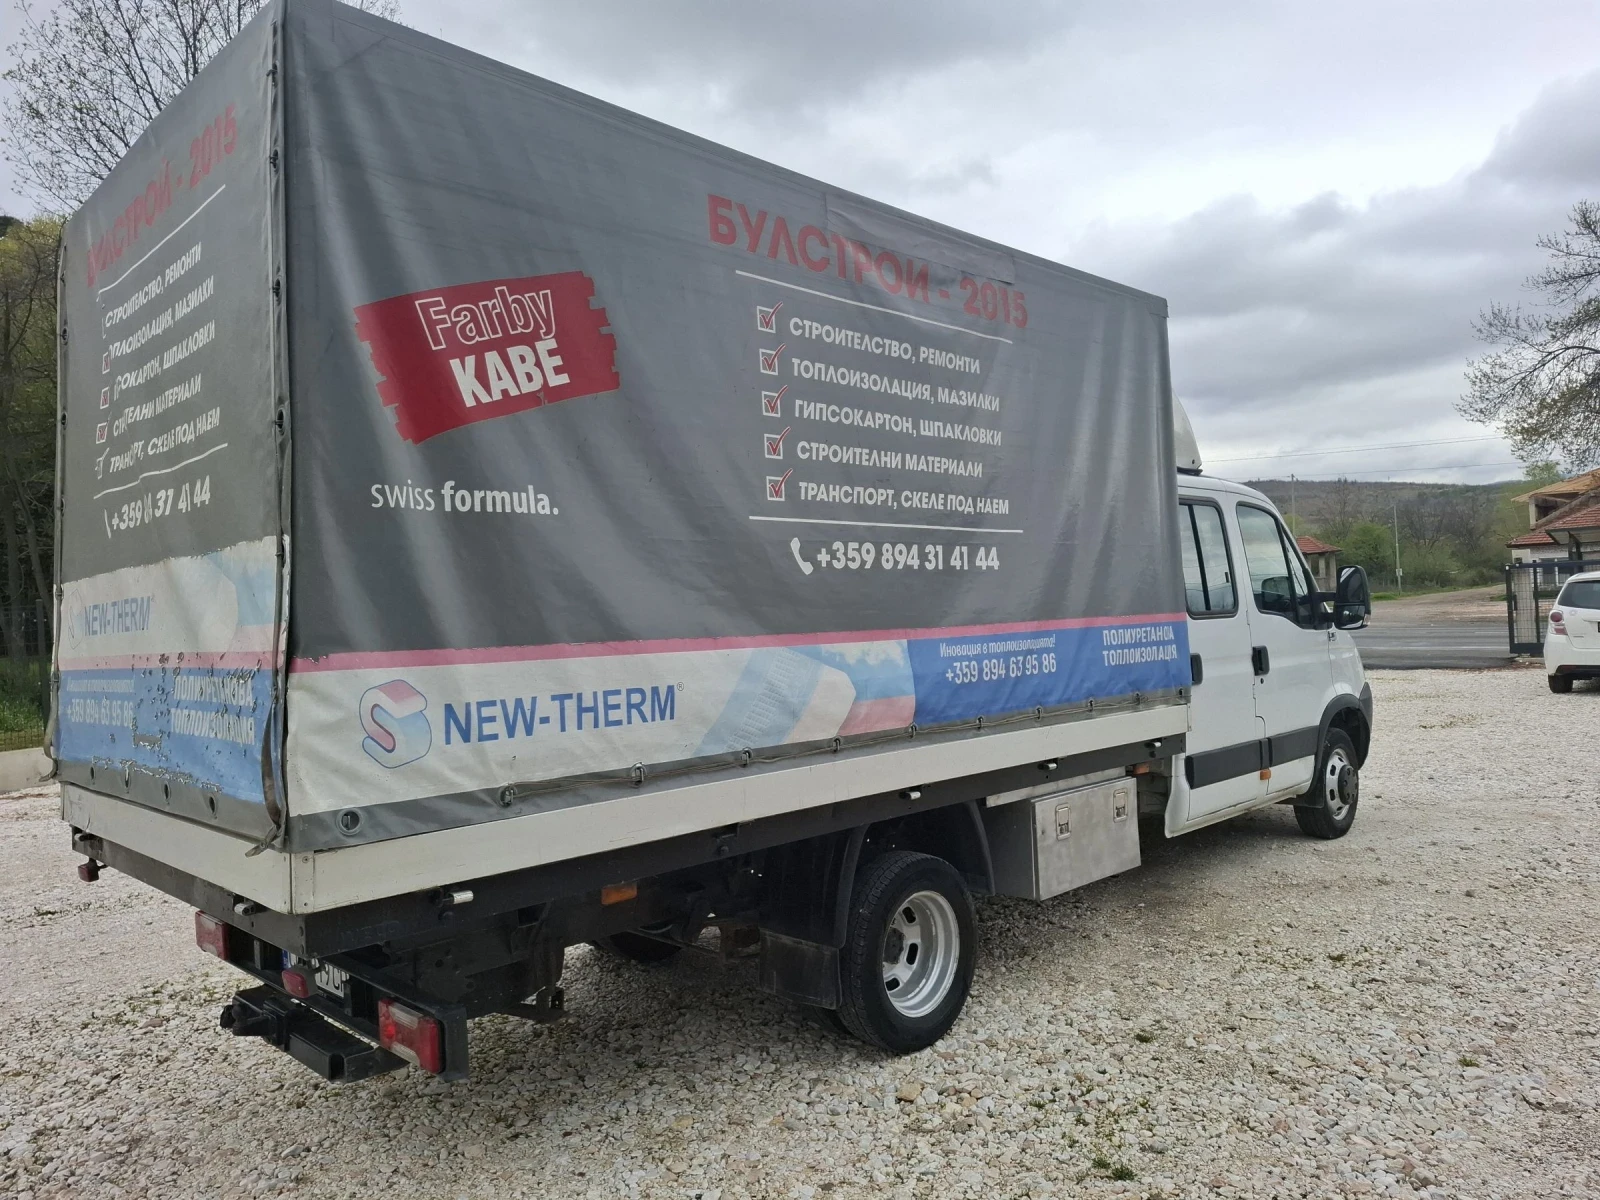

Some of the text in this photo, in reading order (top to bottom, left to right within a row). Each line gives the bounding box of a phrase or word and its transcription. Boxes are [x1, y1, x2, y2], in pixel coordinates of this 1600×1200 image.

[190, 103, 238, 189] 2015
[165, 241, 202, 287] РЕМОНТИ
[175, 275, 214, 322] МАЗИЛКИ
[415, 286, 555, 350] Farby
[960, 277, 1028, 328] 2015
[163, 319, 215, 369] ШПАКЛОВКИ
[789, 318, 980, 374] СТРОИТЕЛСТВО, РЕМОНТИ
[449, 338, 570, 408] KABE
[792, 358, 999, 412] ТОПЛОИЗОЛАЦИЯ, МАЗИЛКИ
[175, 420, 195, 445] ПОД
[196, 406, 220, 436] НАЕМ
[795, 399, 1001, 446] ГИПСОКАРТОН, ШПАКЛОВКИ
[797, 441, 983, 478] СТРОИТЕЛНИ МАТЕРИАЛИ
[112, 500, 142, 530] +359
[193, 475, 211, 507] 44
[371, 479, 559, 515] swiss formula.
[799, 482, 1009, 515] ТРАНСПОРТ, СКЕЛЕ ПОД НАЕМ
[817, 541, 1000, 570] +359 894 31 41 44
[946, 652, 1057, 684] +359 894 63 95 86
